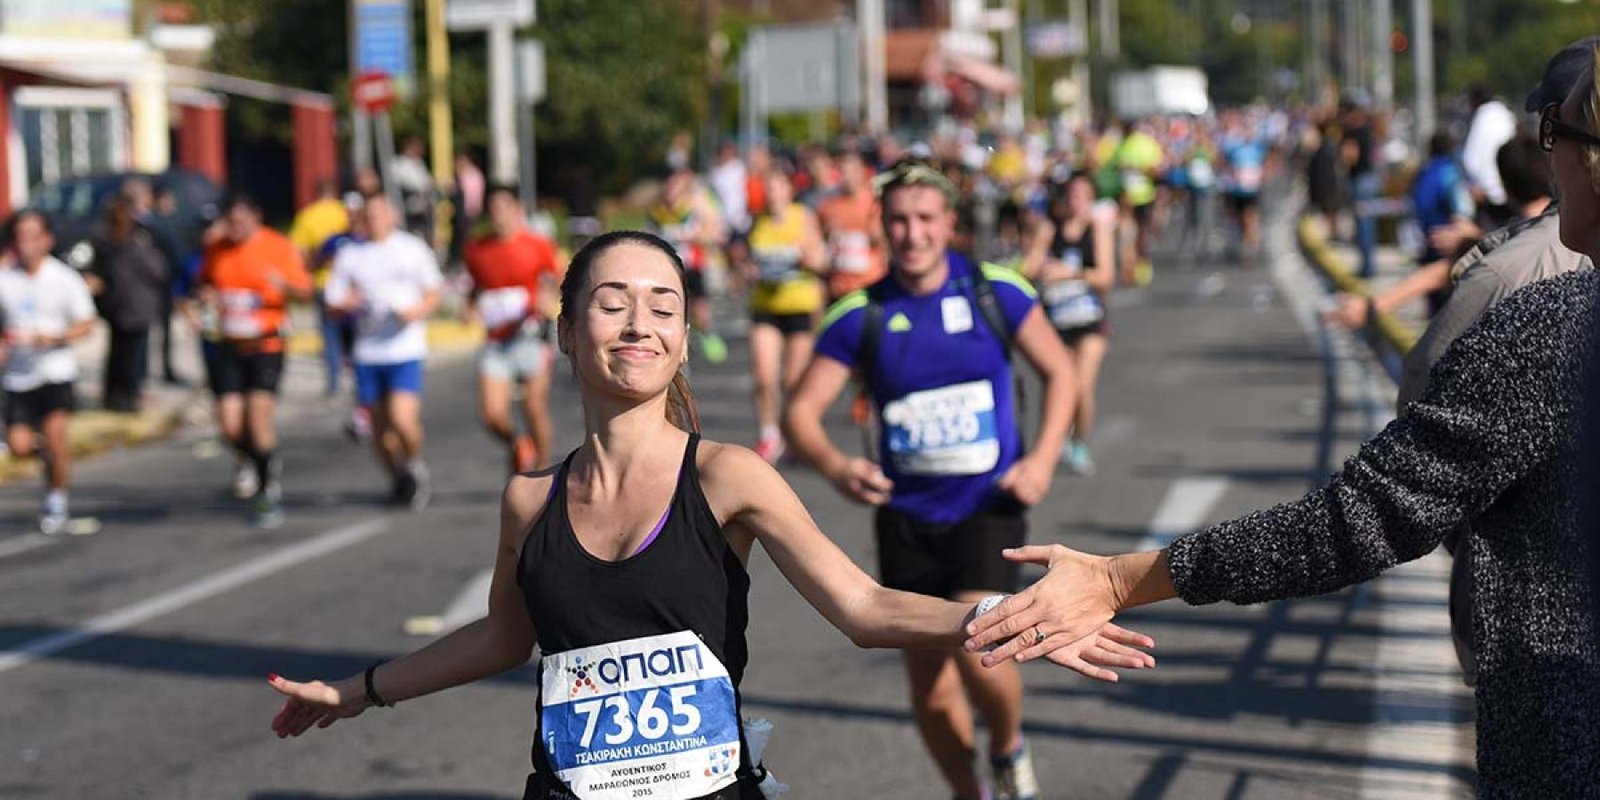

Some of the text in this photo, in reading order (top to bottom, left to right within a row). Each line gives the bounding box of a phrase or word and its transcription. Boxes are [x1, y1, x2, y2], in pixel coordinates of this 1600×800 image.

[574, 685, 701, 748] 7365
[575, 736, 708, 764] ΤΣΑΚΙΡΑΚΗ ΚΩΝΣΤΑΝΤΙΝΑ
[611, 762, 667, 777] ΑΥΘΕΝΤΙΚΟΣ
[653, 769, 692, 784] ΔΡΟΜΟΣ
[632, 787, 653, 798] 2015
